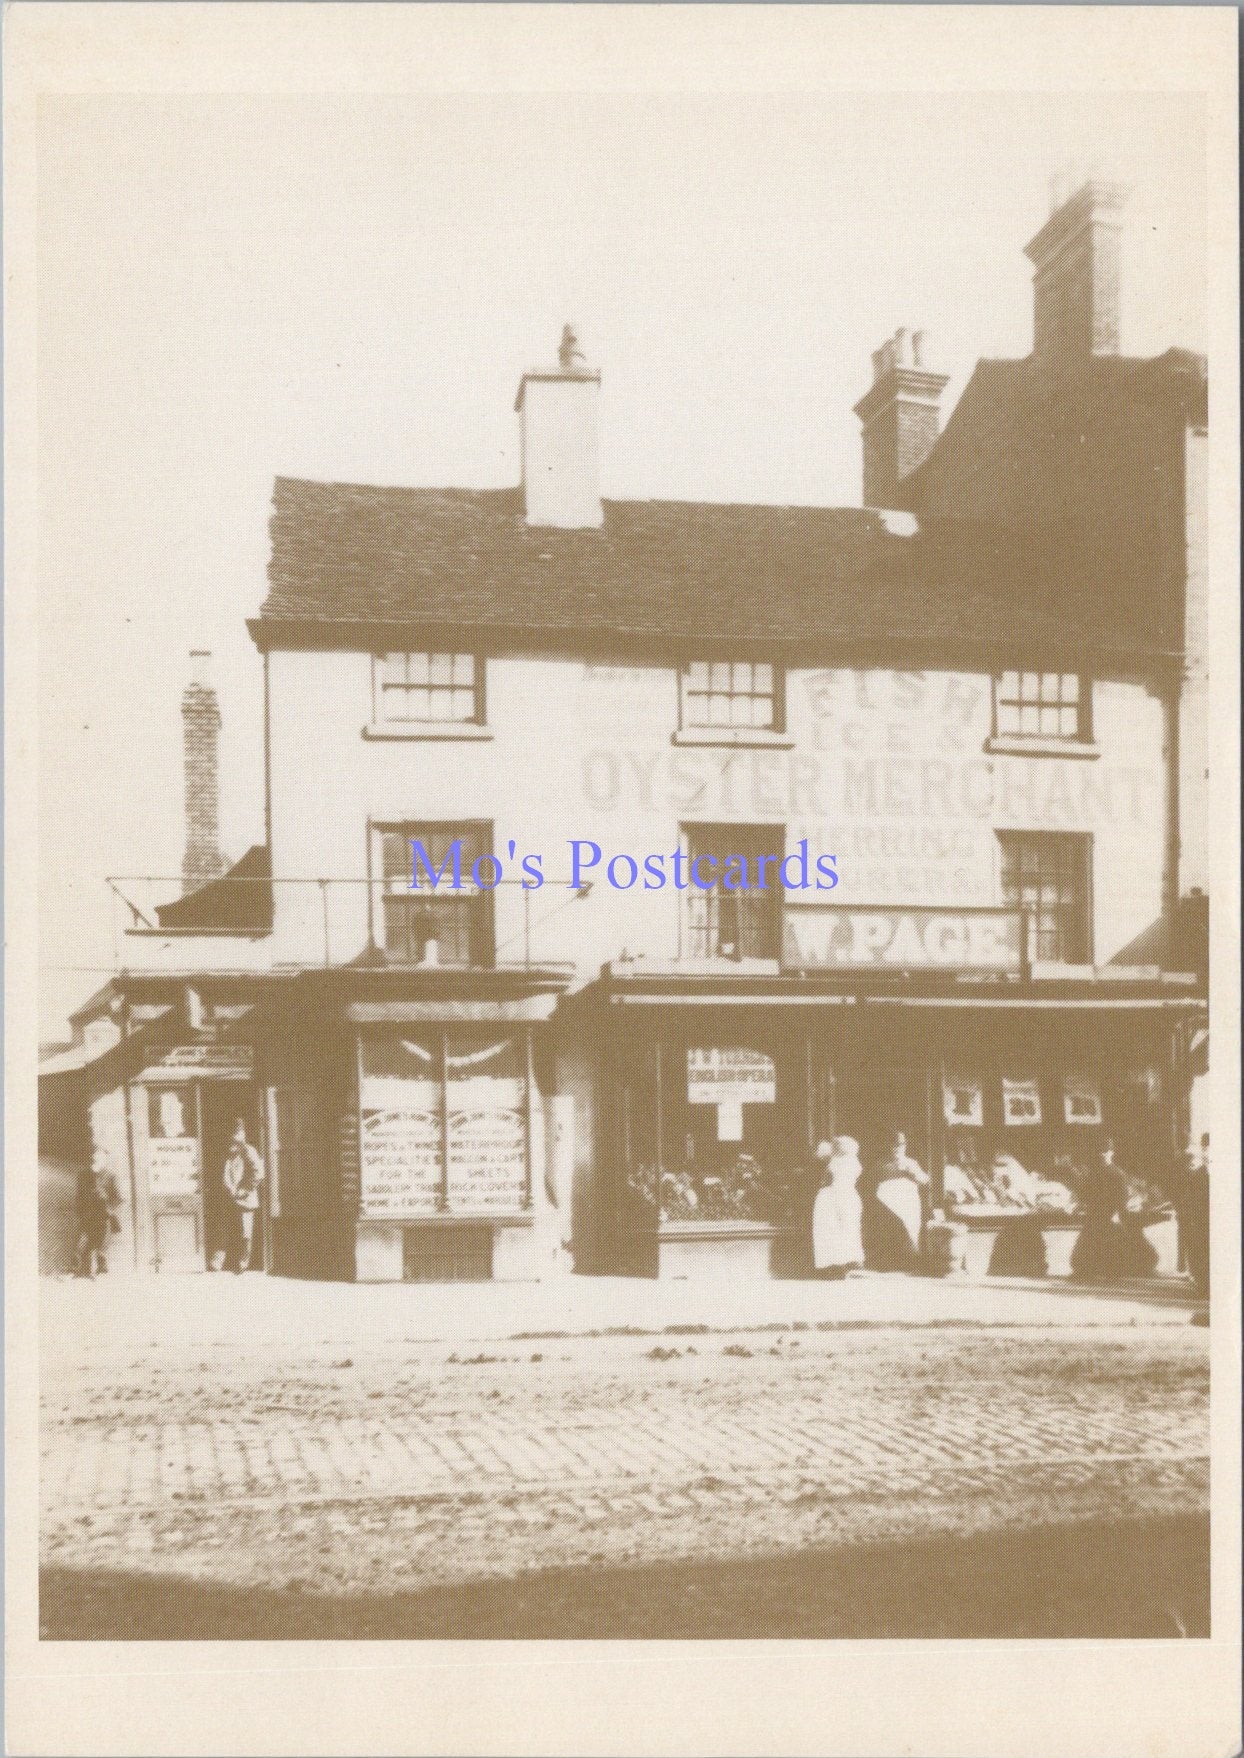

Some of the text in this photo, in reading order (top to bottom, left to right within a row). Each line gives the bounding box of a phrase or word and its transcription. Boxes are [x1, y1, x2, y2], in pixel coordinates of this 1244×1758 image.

[802, 669, 984, 726] FISH
[811, 722, 912, 753] ICE
[580, 749, 1156, 825] OYSTER MERCHANT
[797, 826, 976, 859] HERRING
